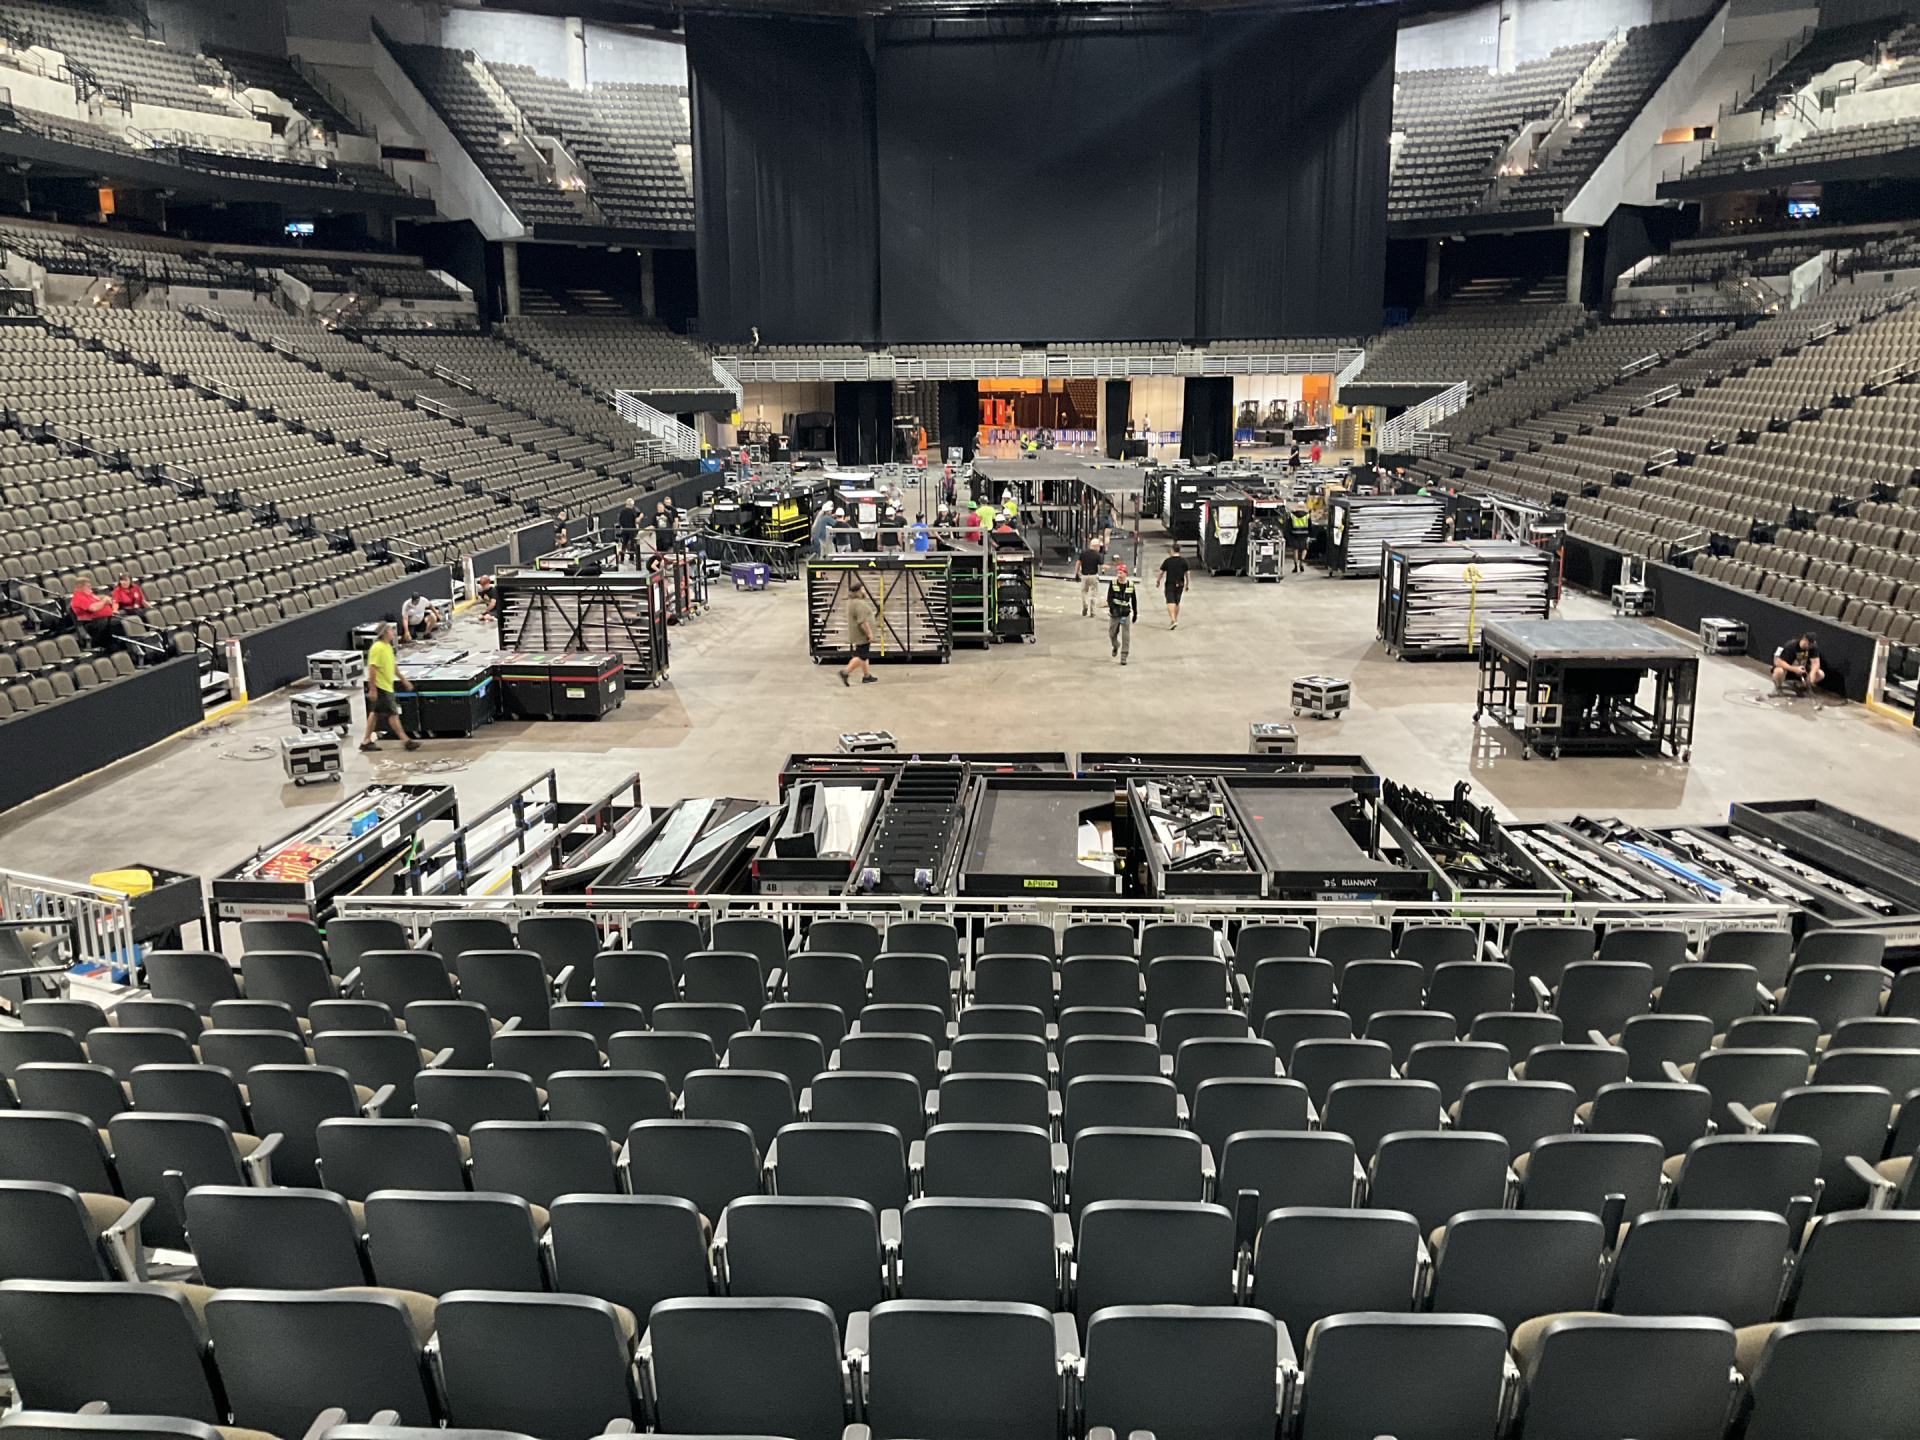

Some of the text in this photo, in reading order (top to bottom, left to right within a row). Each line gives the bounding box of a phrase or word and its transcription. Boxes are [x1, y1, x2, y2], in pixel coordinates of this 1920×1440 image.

[1342, 878, 1378, 887] RUNWAY
[766, 884, 777, 892] 4B
[225, 905, 235, 914] 4A
